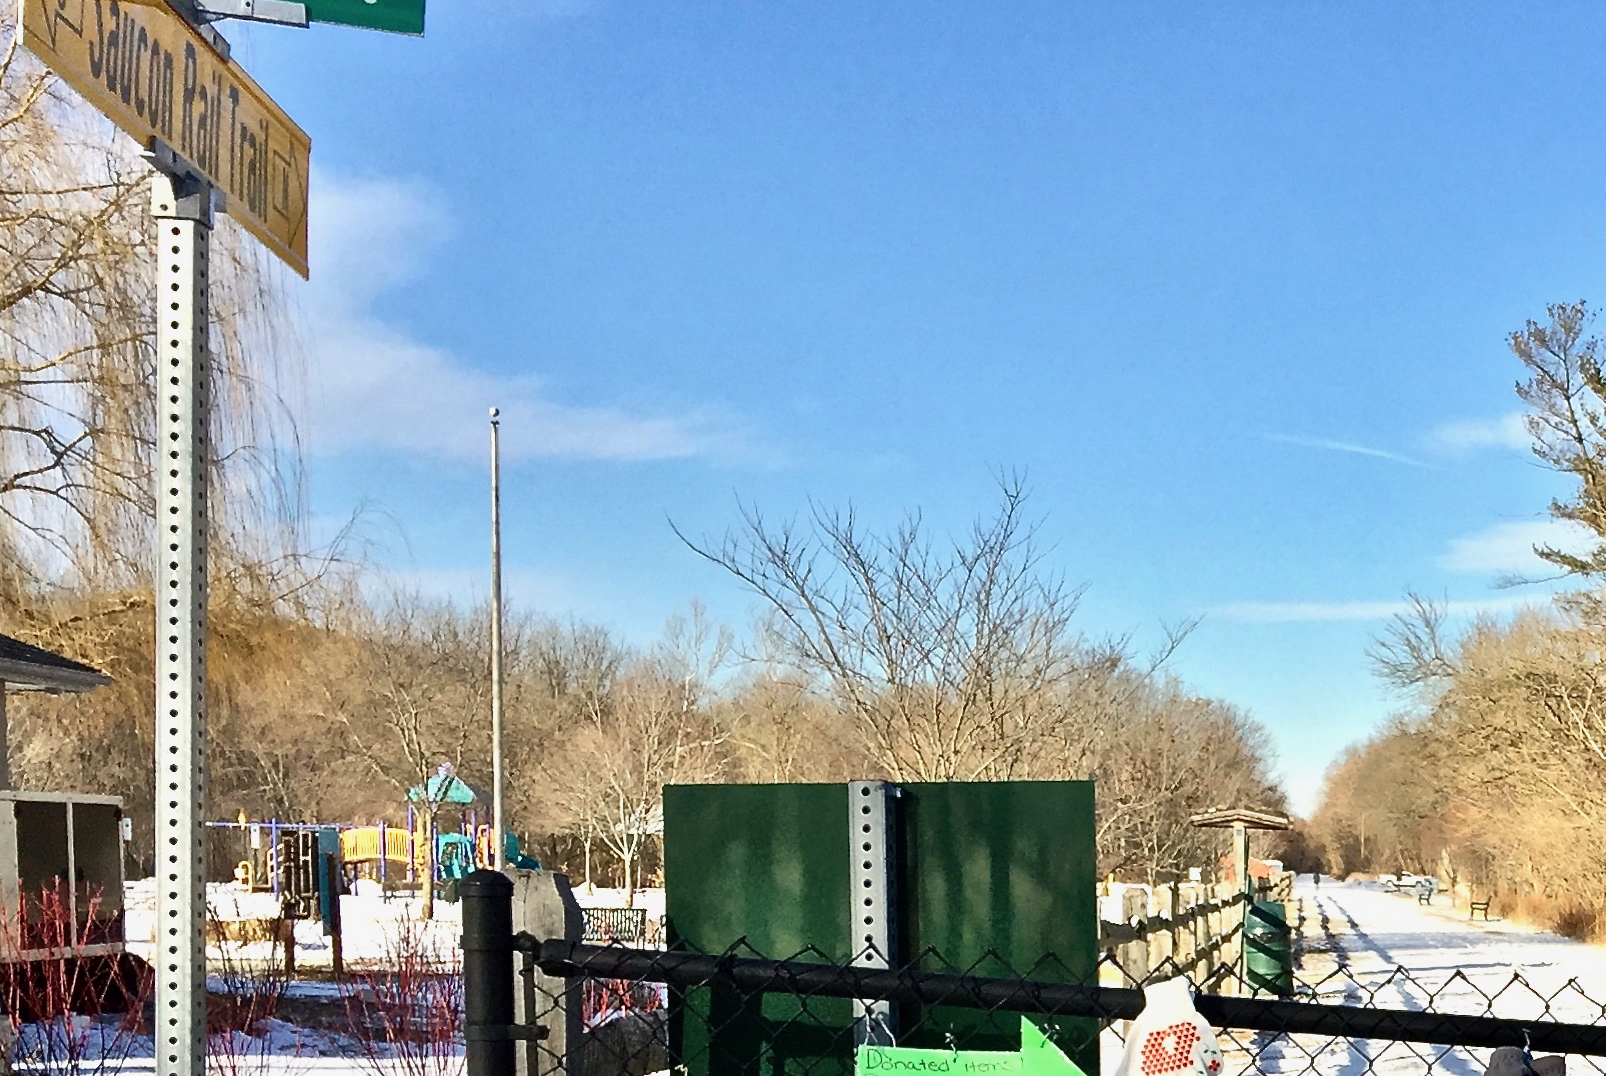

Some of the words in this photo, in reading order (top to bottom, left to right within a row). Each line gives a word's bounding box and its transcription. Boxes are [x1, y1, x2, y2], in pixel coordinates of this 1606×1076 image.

[181, 40, 222, 183] Rail
[229, 85, 269, 222] Trail
[865, 1048, 949, 1071] Donated
